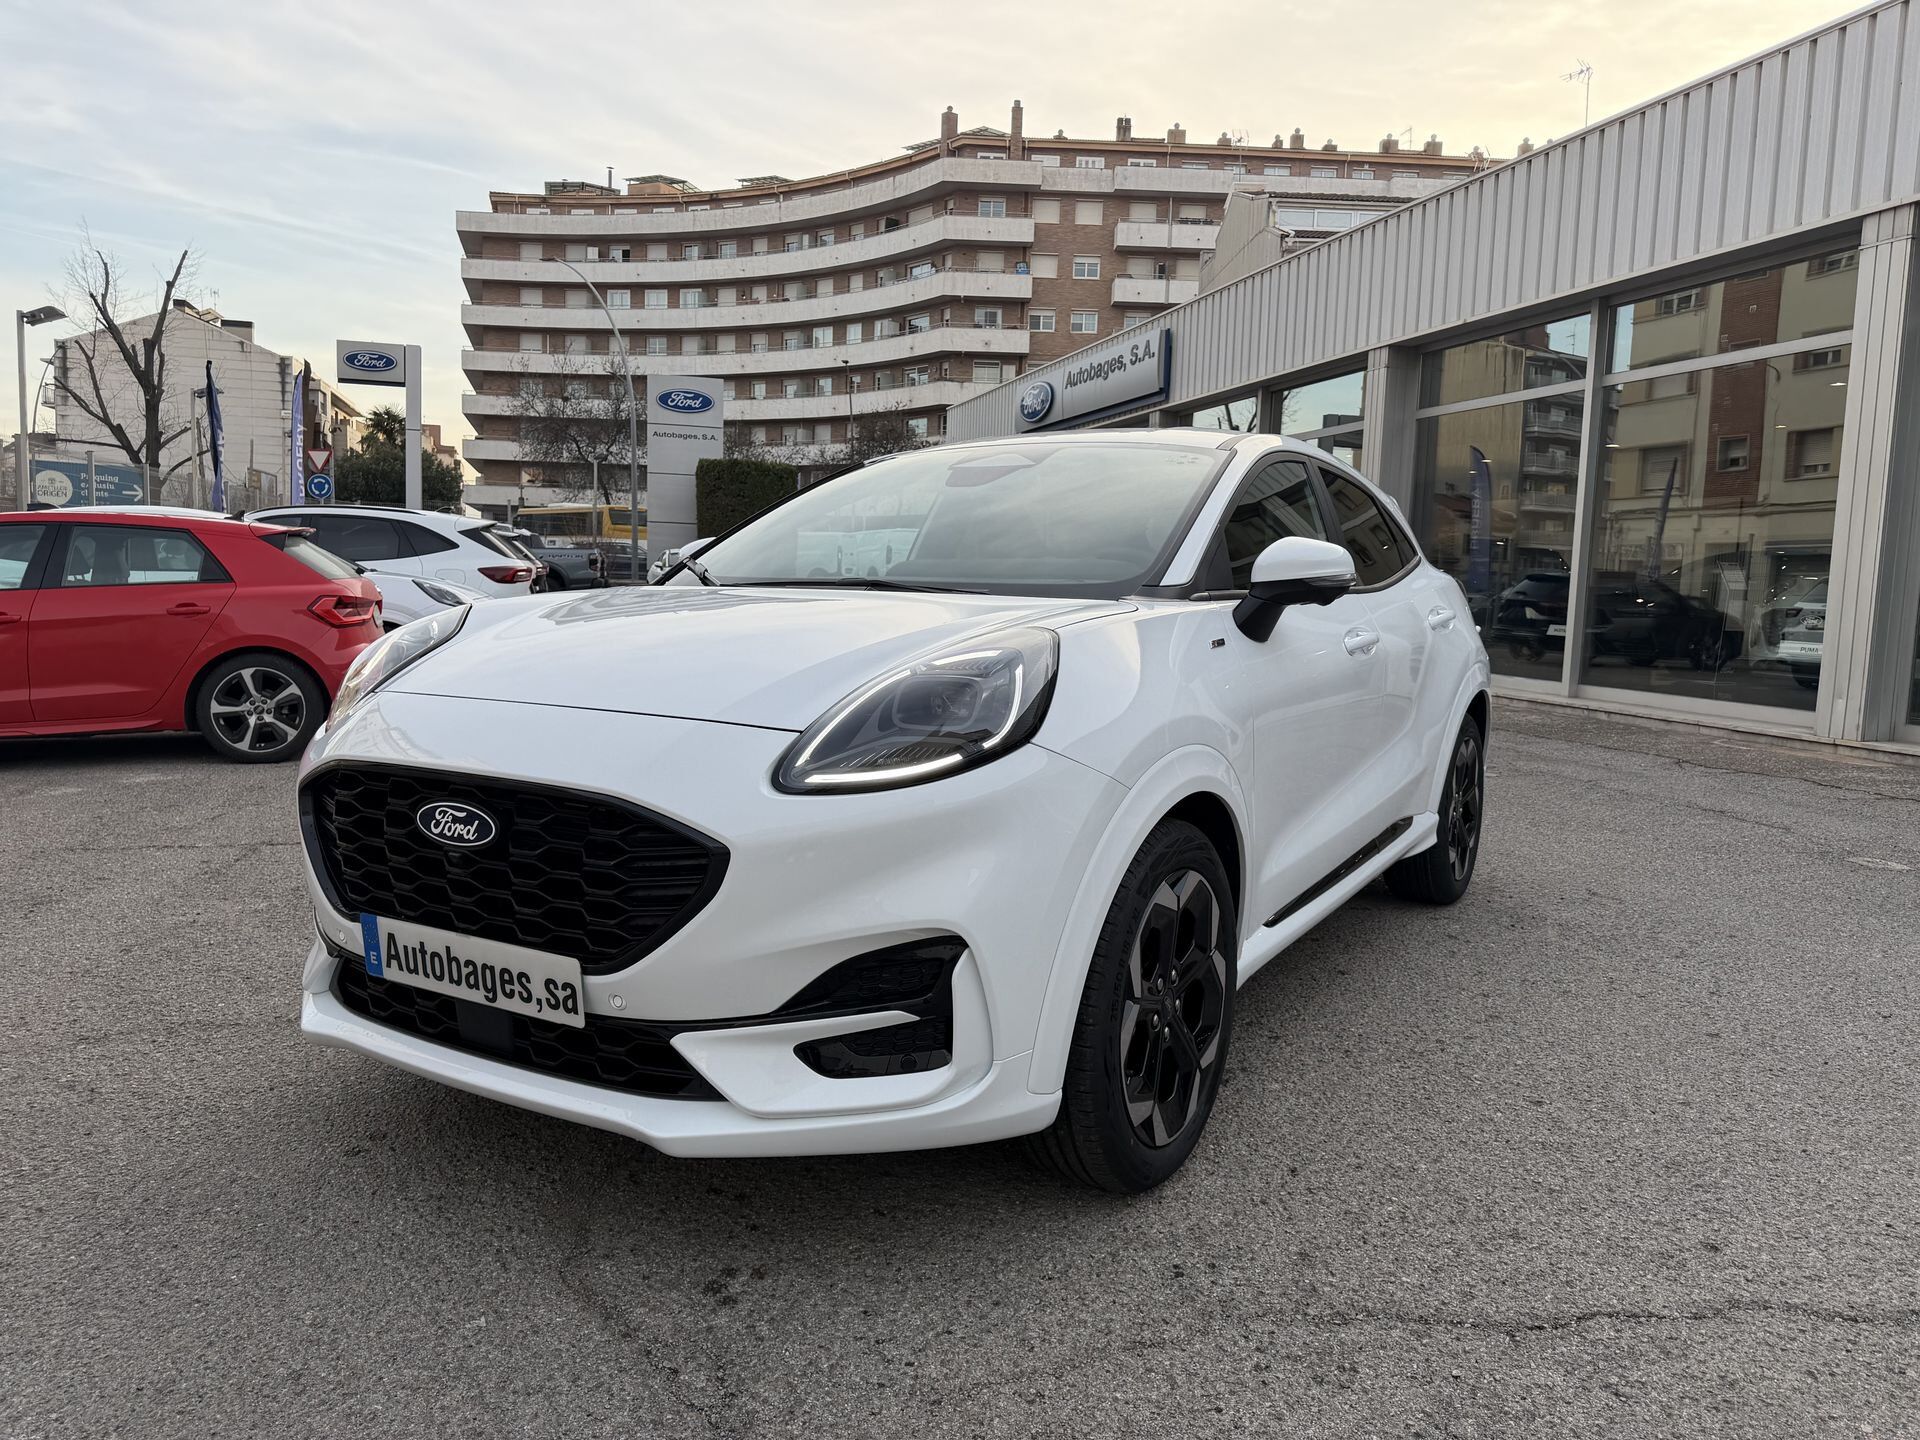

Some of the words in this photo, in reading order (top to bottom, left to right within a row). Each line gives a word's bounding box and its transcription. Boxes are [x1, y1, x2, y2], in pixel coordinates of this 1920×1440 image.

[354, 353, 387, 368] Ford
[1064, 354, 1127, 390] Autobages,
[1129, 339, 1156, 366] S.A.
[667, 392, 703, 408] Ford
[1022, 388, 1045, 416] Ford
[652, 431, 700, 440] Autobages,
[701, 433, 719, 441] S.A.
[80, 472, 119, 483] Pquing
[80, 482, 115, 490] elusiu
[80, 489, 109, 497] clnts
[37, 490, 68, 498] ORIGEN
[430, 807, 478, 840] Ford
[370, 951, 378, 964] E
[385, 932, 580, 1016] Autobages,sa
